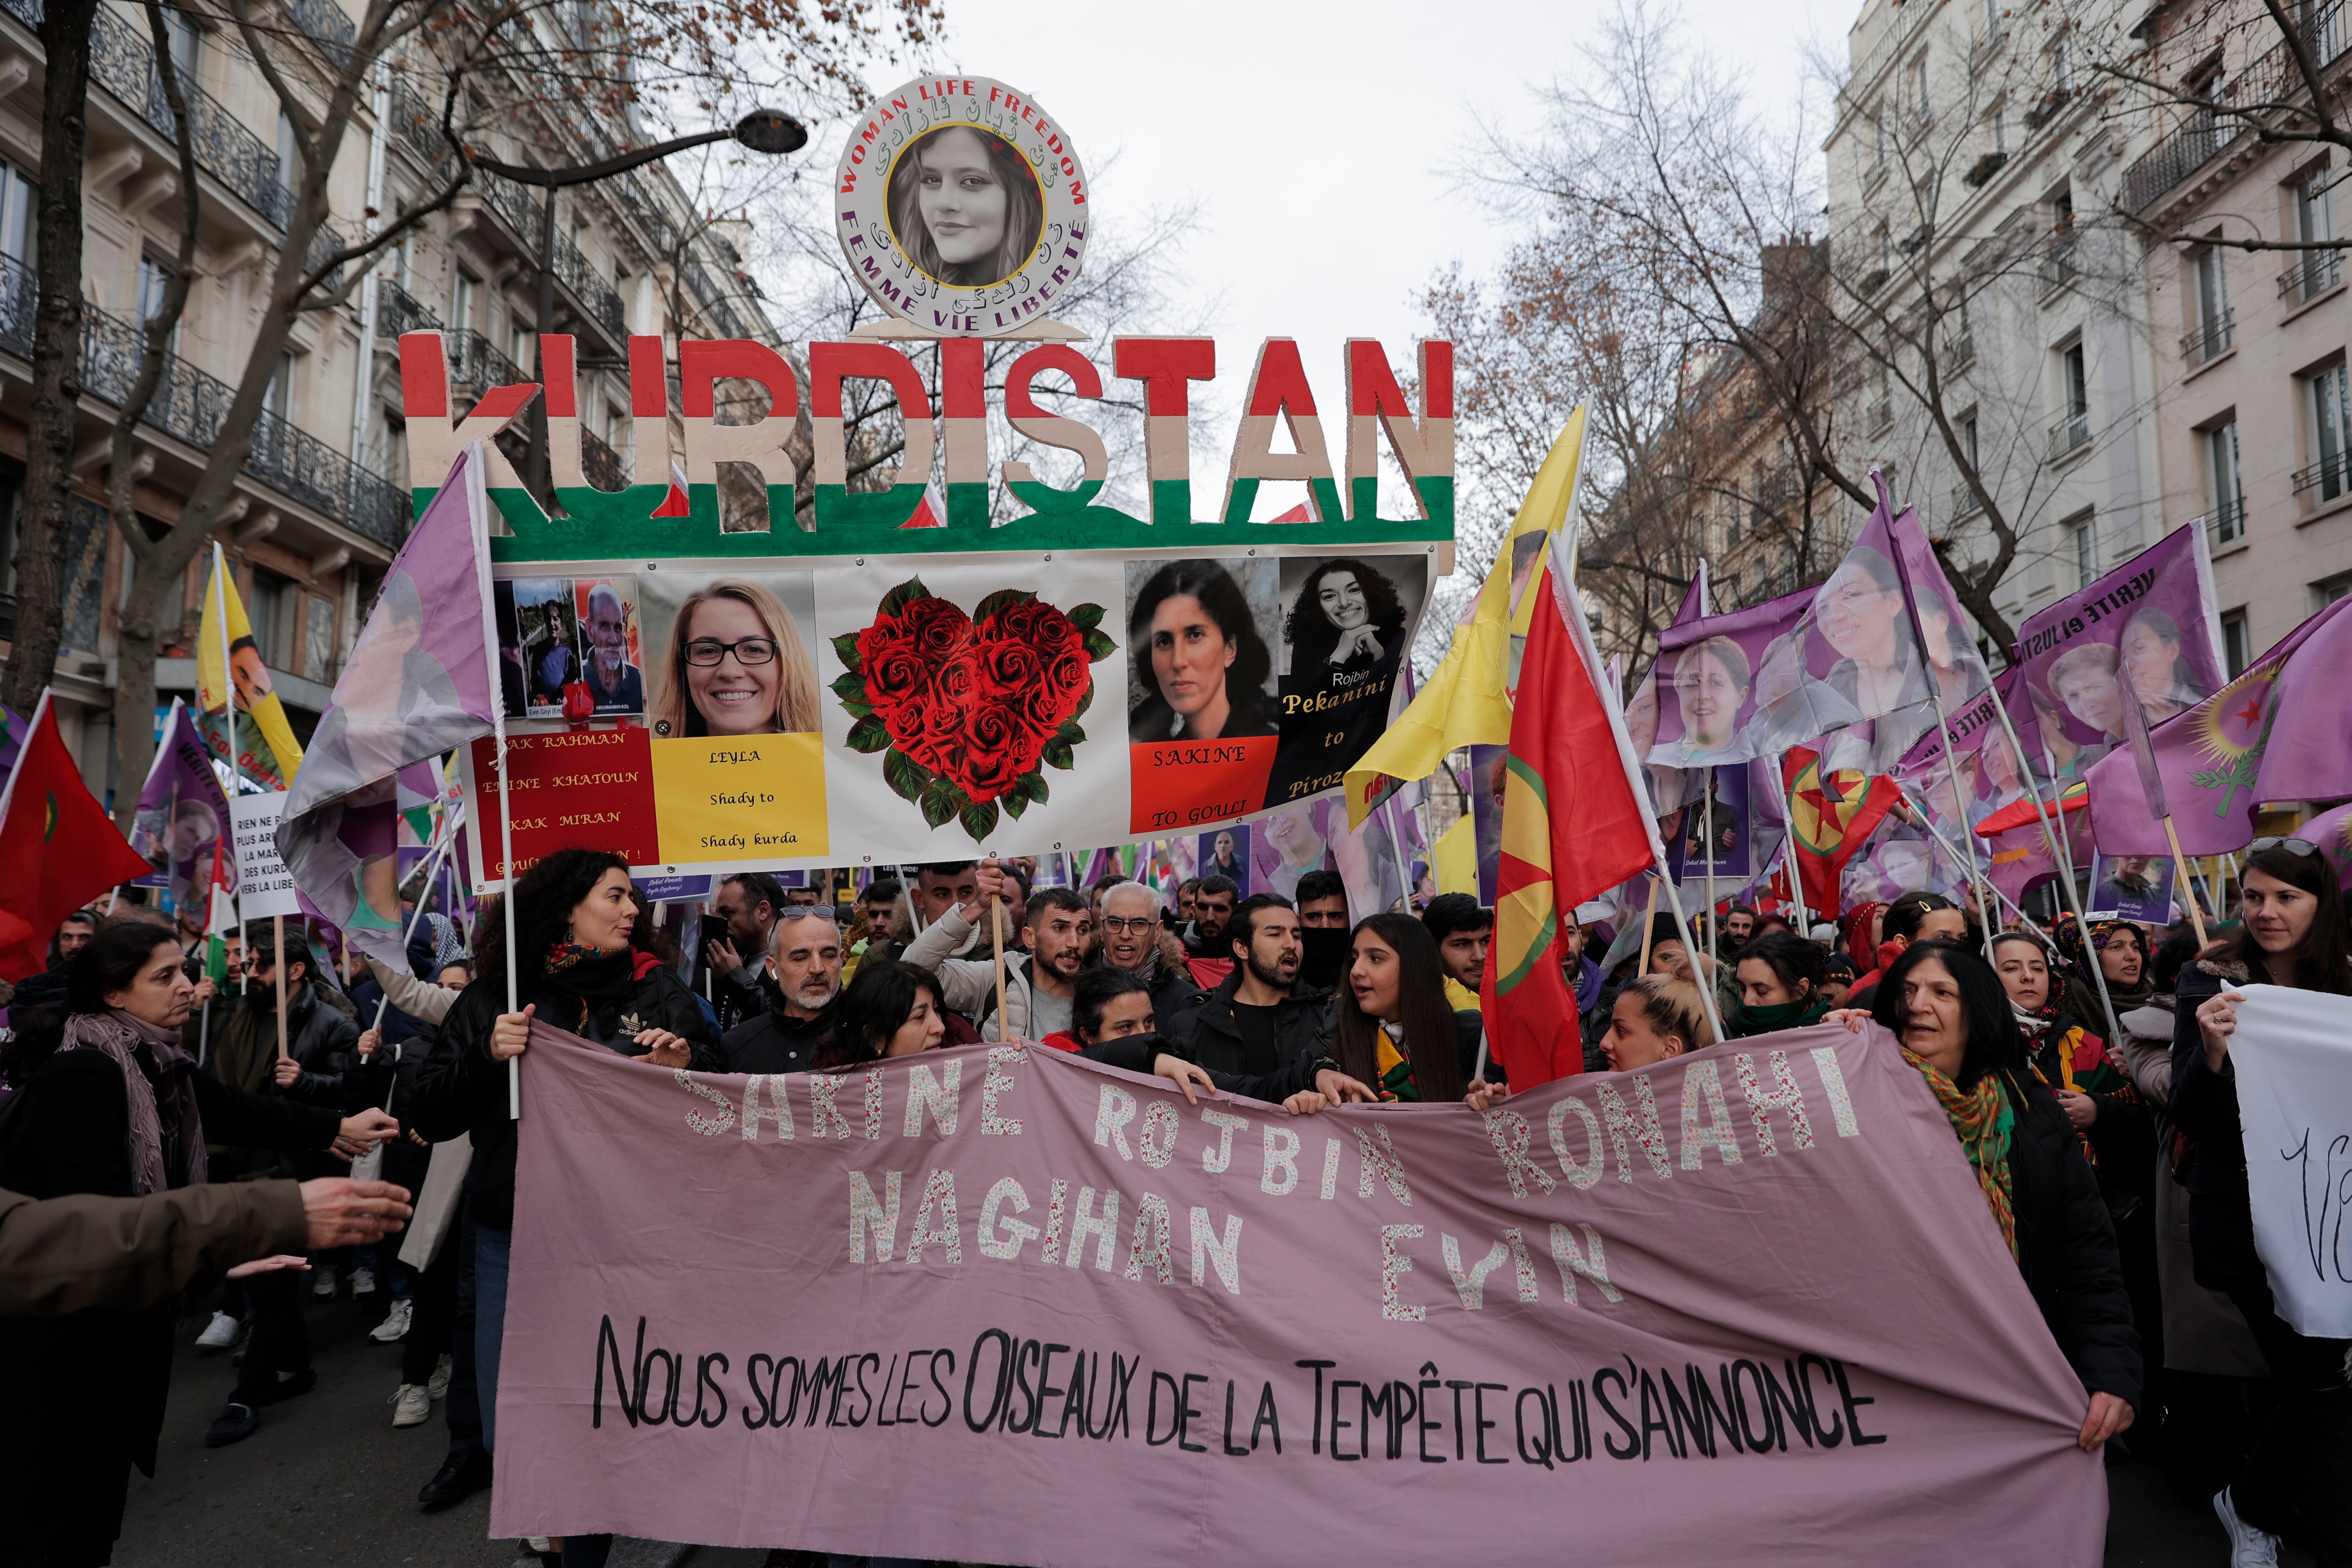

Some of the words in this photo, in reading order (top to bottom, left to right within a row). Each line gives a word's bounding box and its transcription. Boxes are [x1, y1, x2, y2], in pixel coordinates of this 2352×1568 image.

[840, 94, 908, 194] WOMAN
[919, 80, 976, 101] LIFE
[989, 86, 1086, 205] FREEDOM
[841, 210, 919, 316] FEMME
[933, 309, 980, 331] VIE
[995, 219, 1086, 328] LIBERTÉ
[398, 329, 1455, 542] KURDISTAN
[1332, 669, 1369, 687] Rojbin
[542, 733, 625, 747] RAHMAN
[1325, 731, 1344, 747] to
[709, 750, 762, 764] LEYLA
[1153, 746, 1246, 766] SAKINE
[238, 750, 286, 791] Öcala
[552, 772, 639, 787] KHATOUN
[1289, 770, 1343, 799] Piroz
[710, 791, 754, 807] Shady
[760, 793, 774, 802] to
[509, 818, 548, 830] KAK
[559, 812, 621, 826] MIRAN
[1152, 811, 1178, 827] TO
[1188, 799, 1247, 824] GOULI
[238, 818, 256, 830] RIEN
[260, 816, 272, 827] NE
[236, 835, 255, 847] PLUS
[701, 834, 745, 850] Shady
[754, 831, 798, 845] kurda
[245, 851, 254, 861] LA
[257, 848, 279, 860] MAR
[245, 867, 258, 878] DES
[261, 864, 287, 876] KURD
[240, 884, 256, 894] VERS
[259, 882, 270, 891] LA
[273, 879, 294, 890] LIBE
[674, 1046, 1028, 1140] SAKINE
[1093, 1083, 1413, 1207] ROJBIN
[1483, 1047, 1860, 1200] RONAHI
[849, 1169, 1243, 1295] NAGIHAN
[742, 1352, 879, 1430] SOMMES
[877, 1349, 955, 1427] LES
[963, 1327, 1141, 1442] OISEAUX
[1147, 1369, 1209, 1452] DE
[1223, 1379, 1283, 1456] LA
[1294, 1359, 1509, 1465] TEMPÊTE
[1513, 1378, 1592, 1471] QUI
